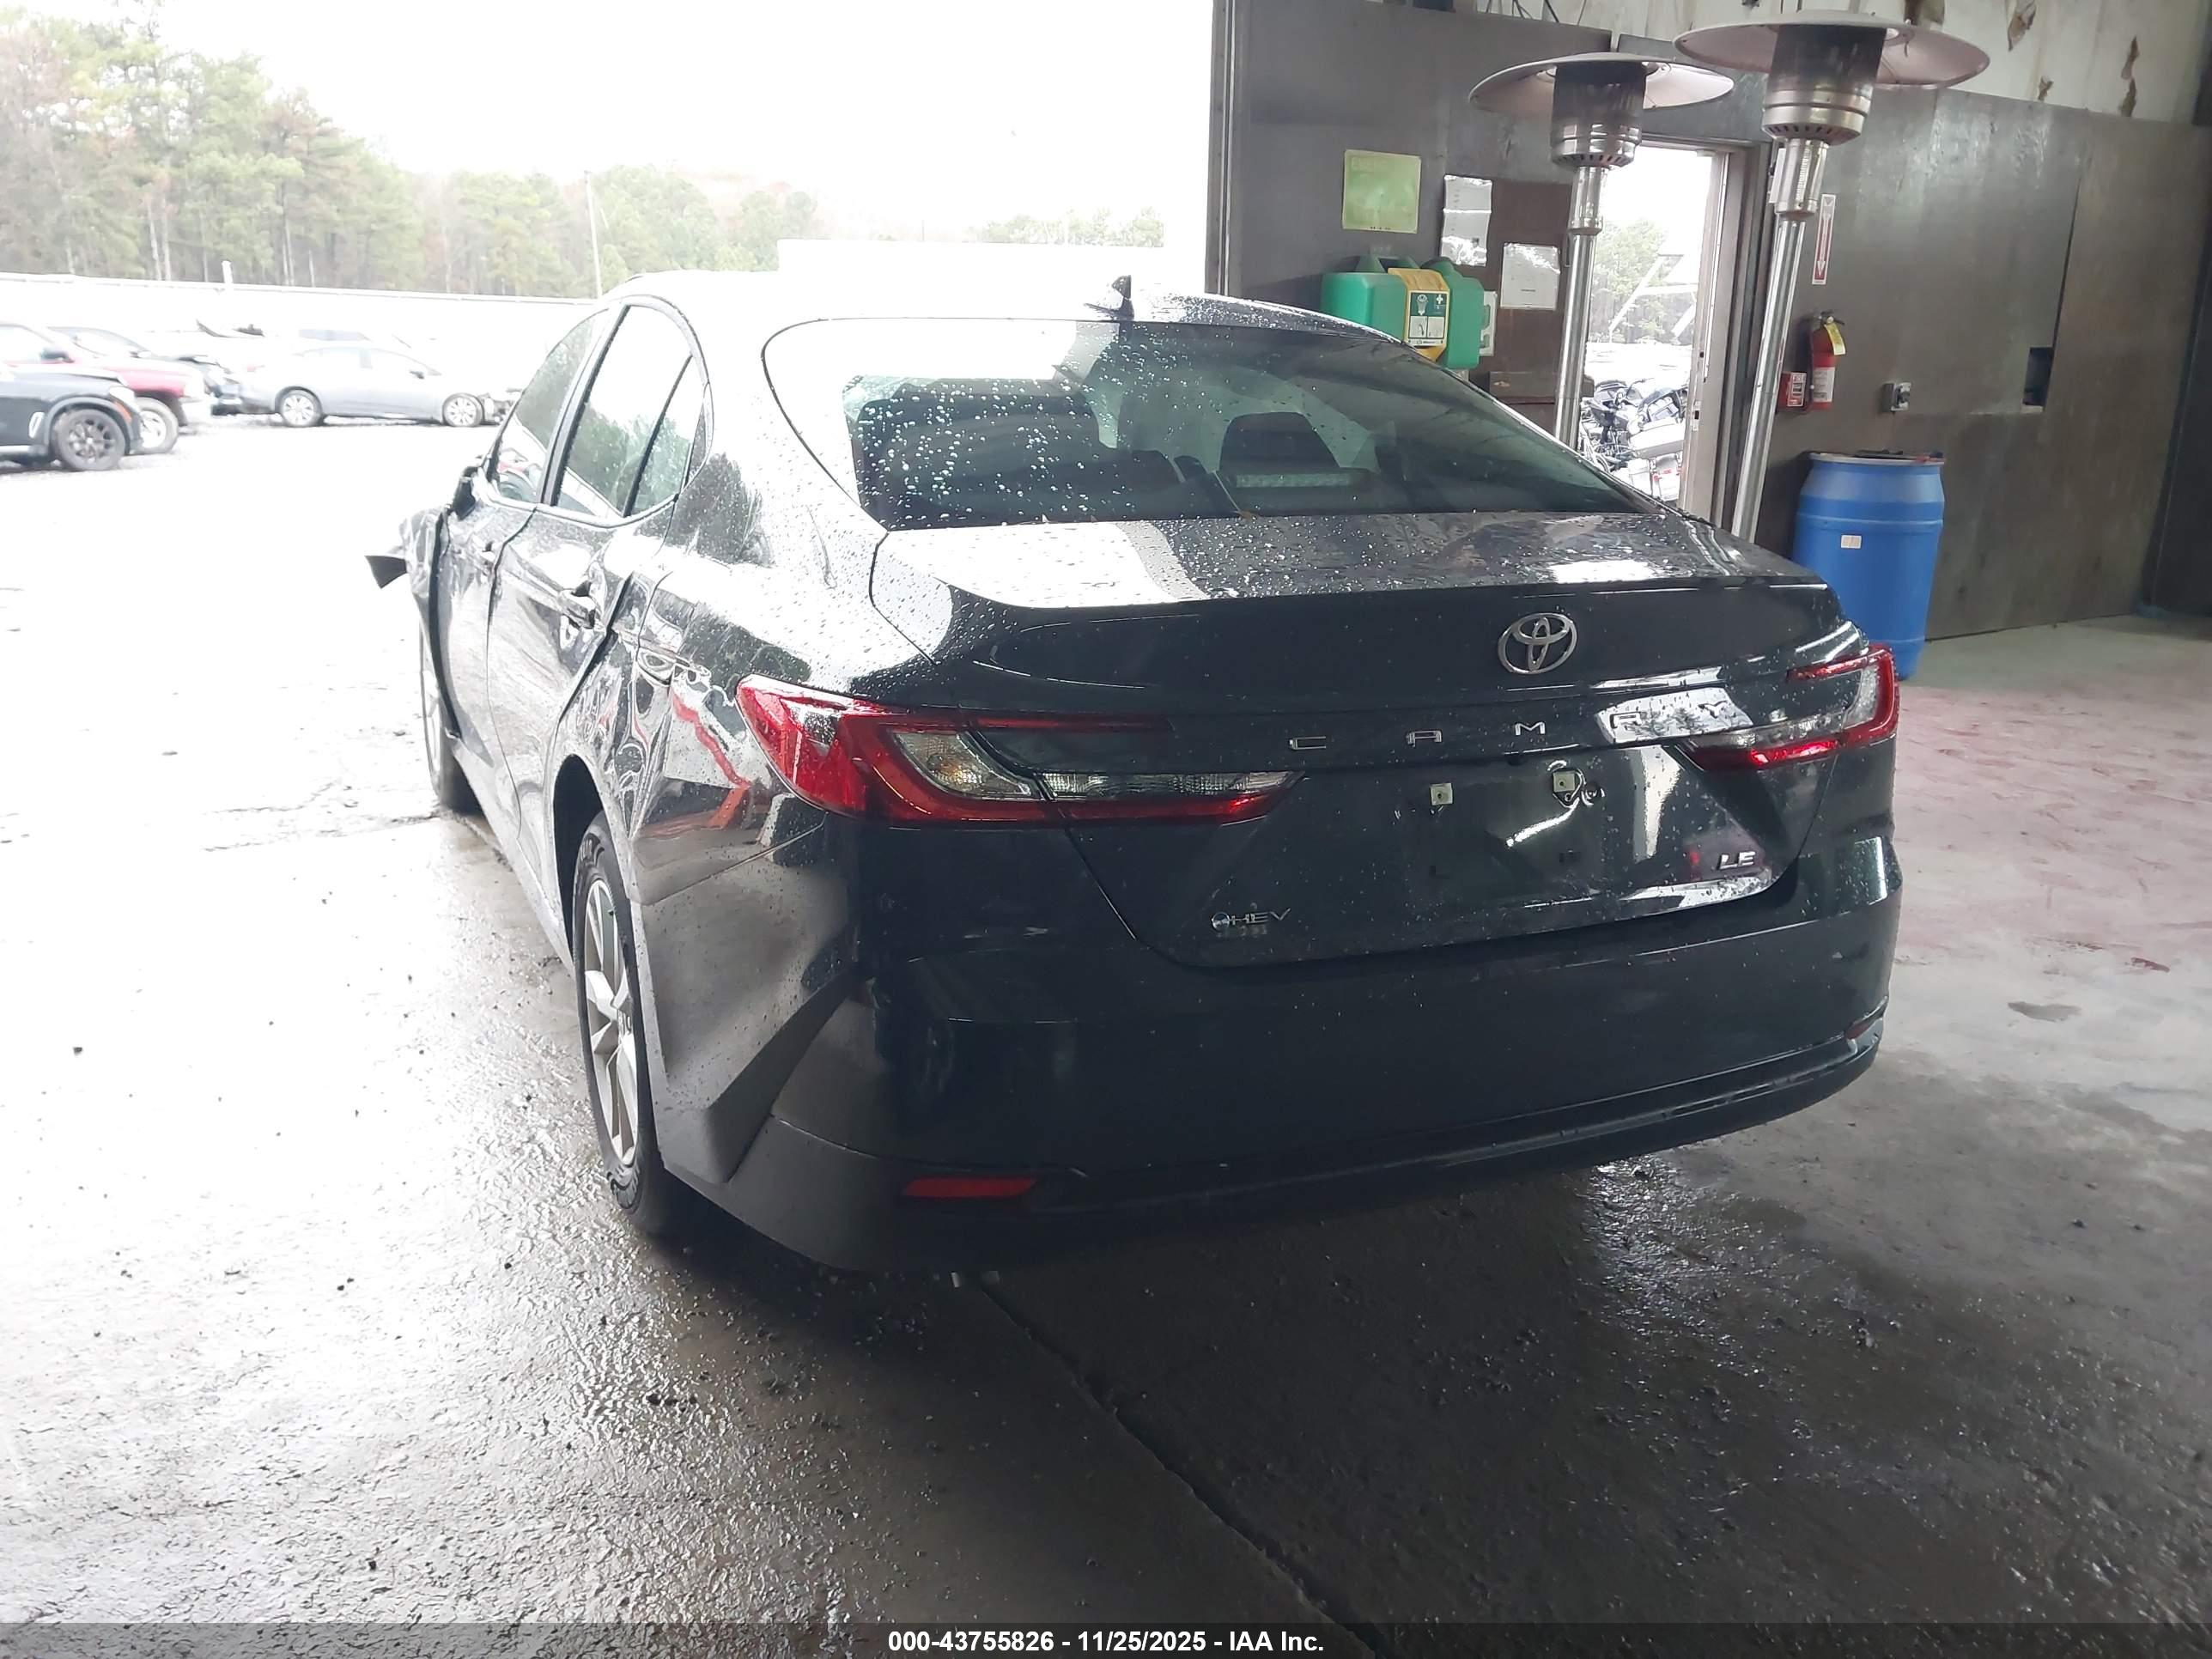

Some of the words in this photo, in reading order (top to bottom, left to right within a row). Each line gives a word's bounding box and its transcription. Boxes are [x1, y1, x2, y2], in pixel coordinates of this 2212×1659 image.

[1289, 698, 1733, 750] CAMRY
[1717, 851, 1756, 869] LE
[1231, 908, 1291, 926] HEV
